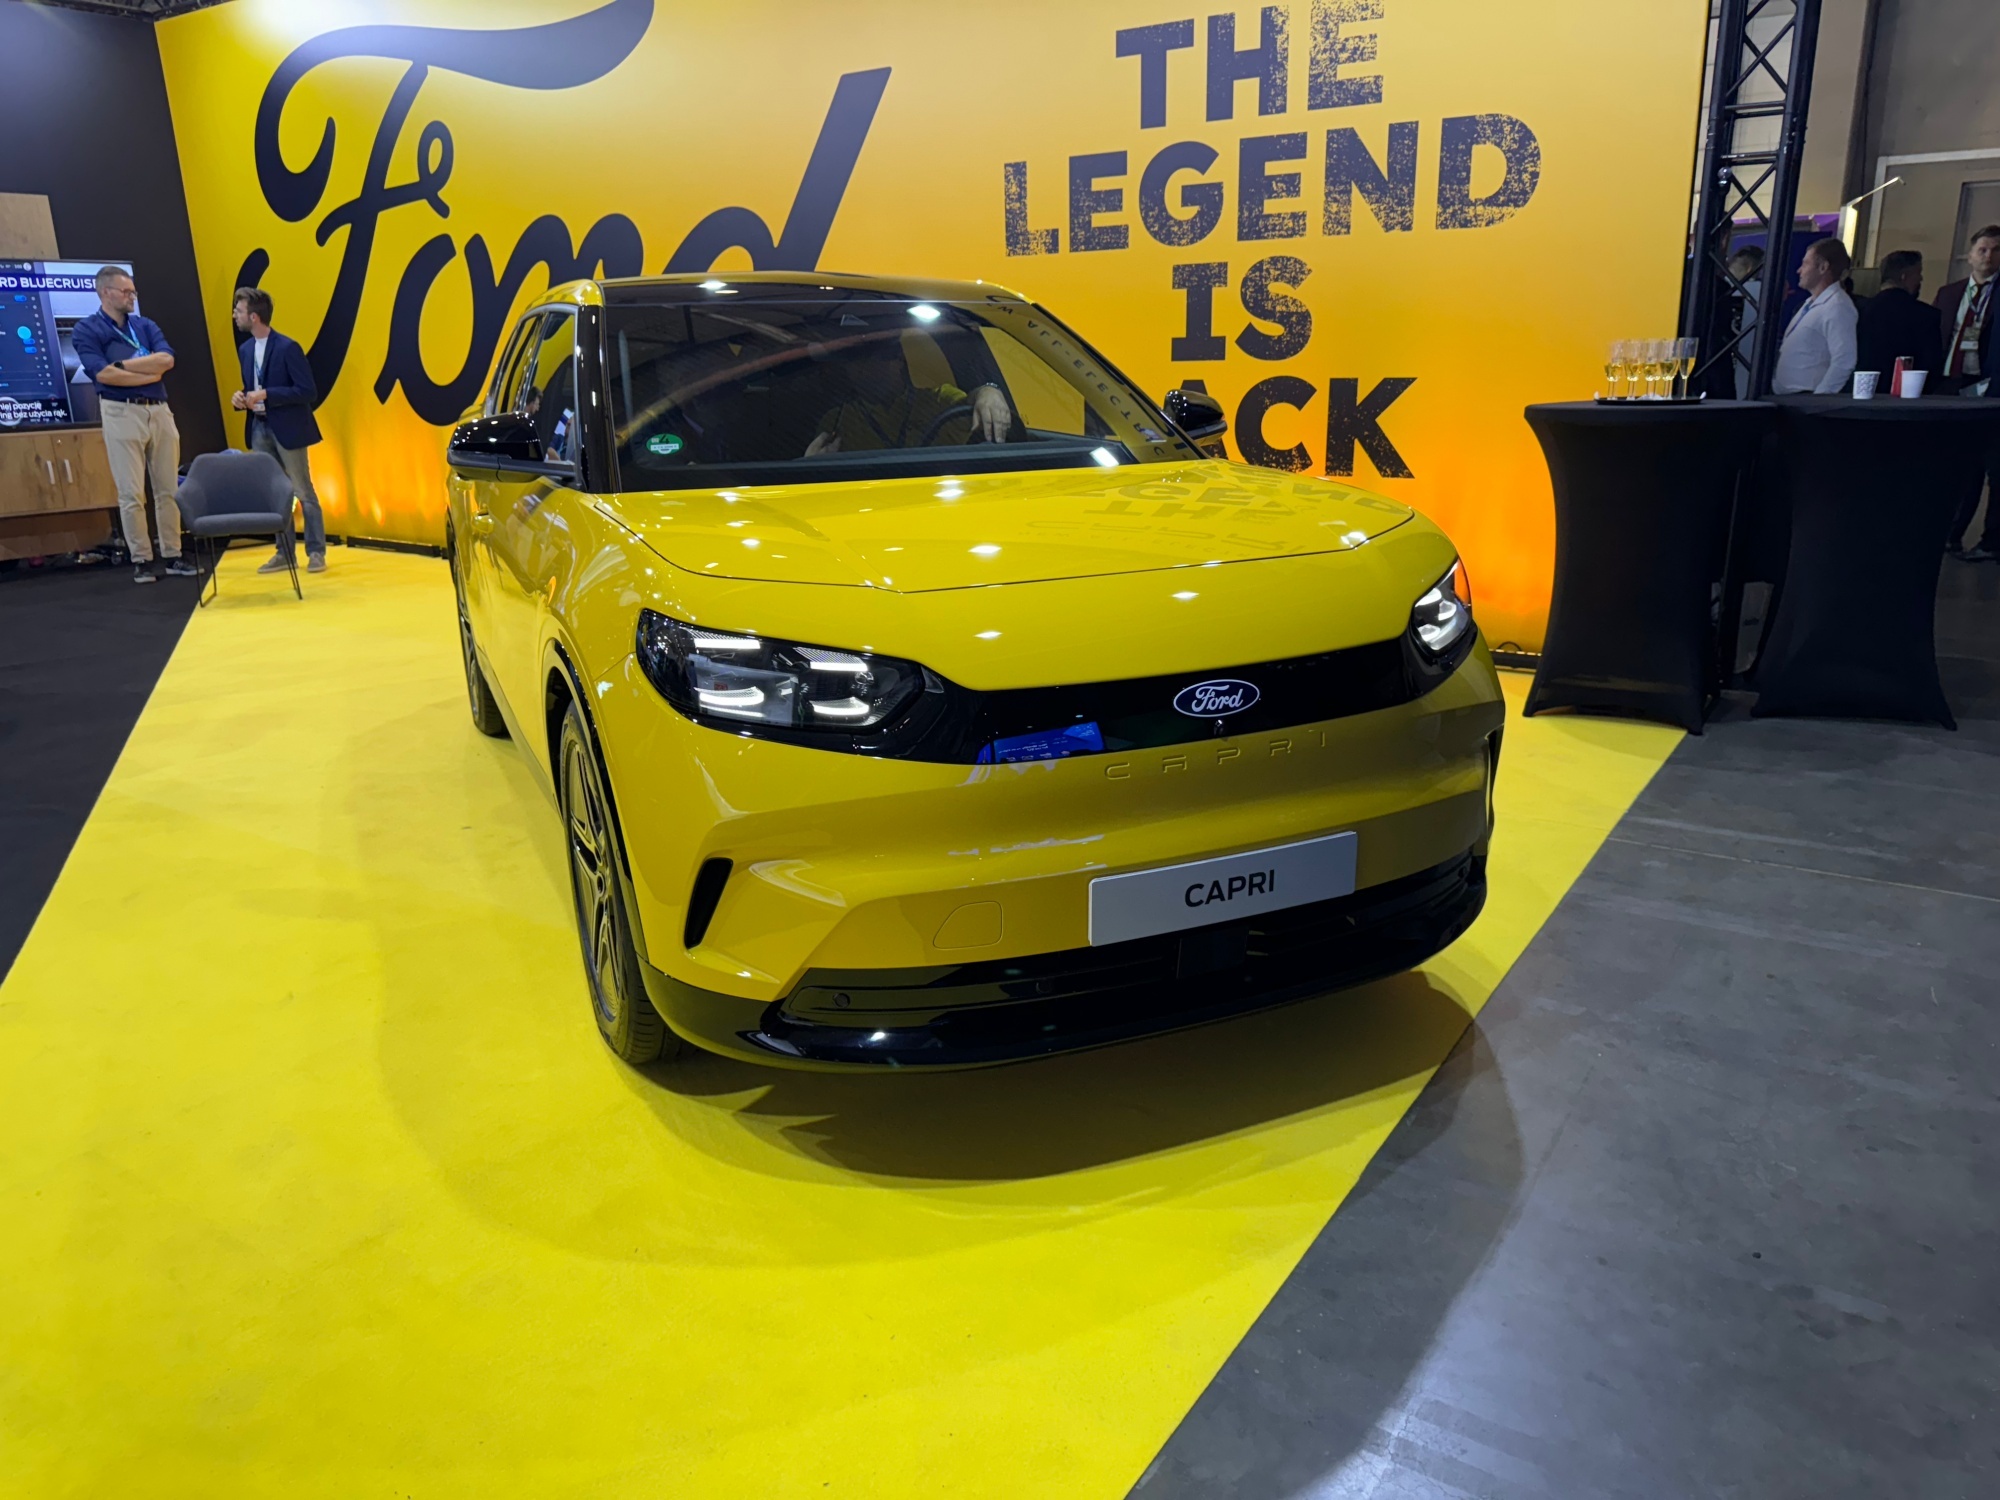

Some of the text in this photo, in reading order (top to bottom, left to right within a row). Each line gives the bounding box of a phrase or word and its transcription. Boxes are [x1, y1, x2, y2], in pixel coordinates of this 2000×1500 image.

[1116, 0, 1385, 130] THE
[234, 0, 892, 426] Ford
[1004, 112, 1541, 257] LEGEND
[1171, 255, 1314, 362] IS
[13, 411, 28, 419] bez
[1191, 684, 1244, 712] Ford
[1105, 731, 1326, 780] CAPRI
[1184, 869, 1276, 908] CAPRI
